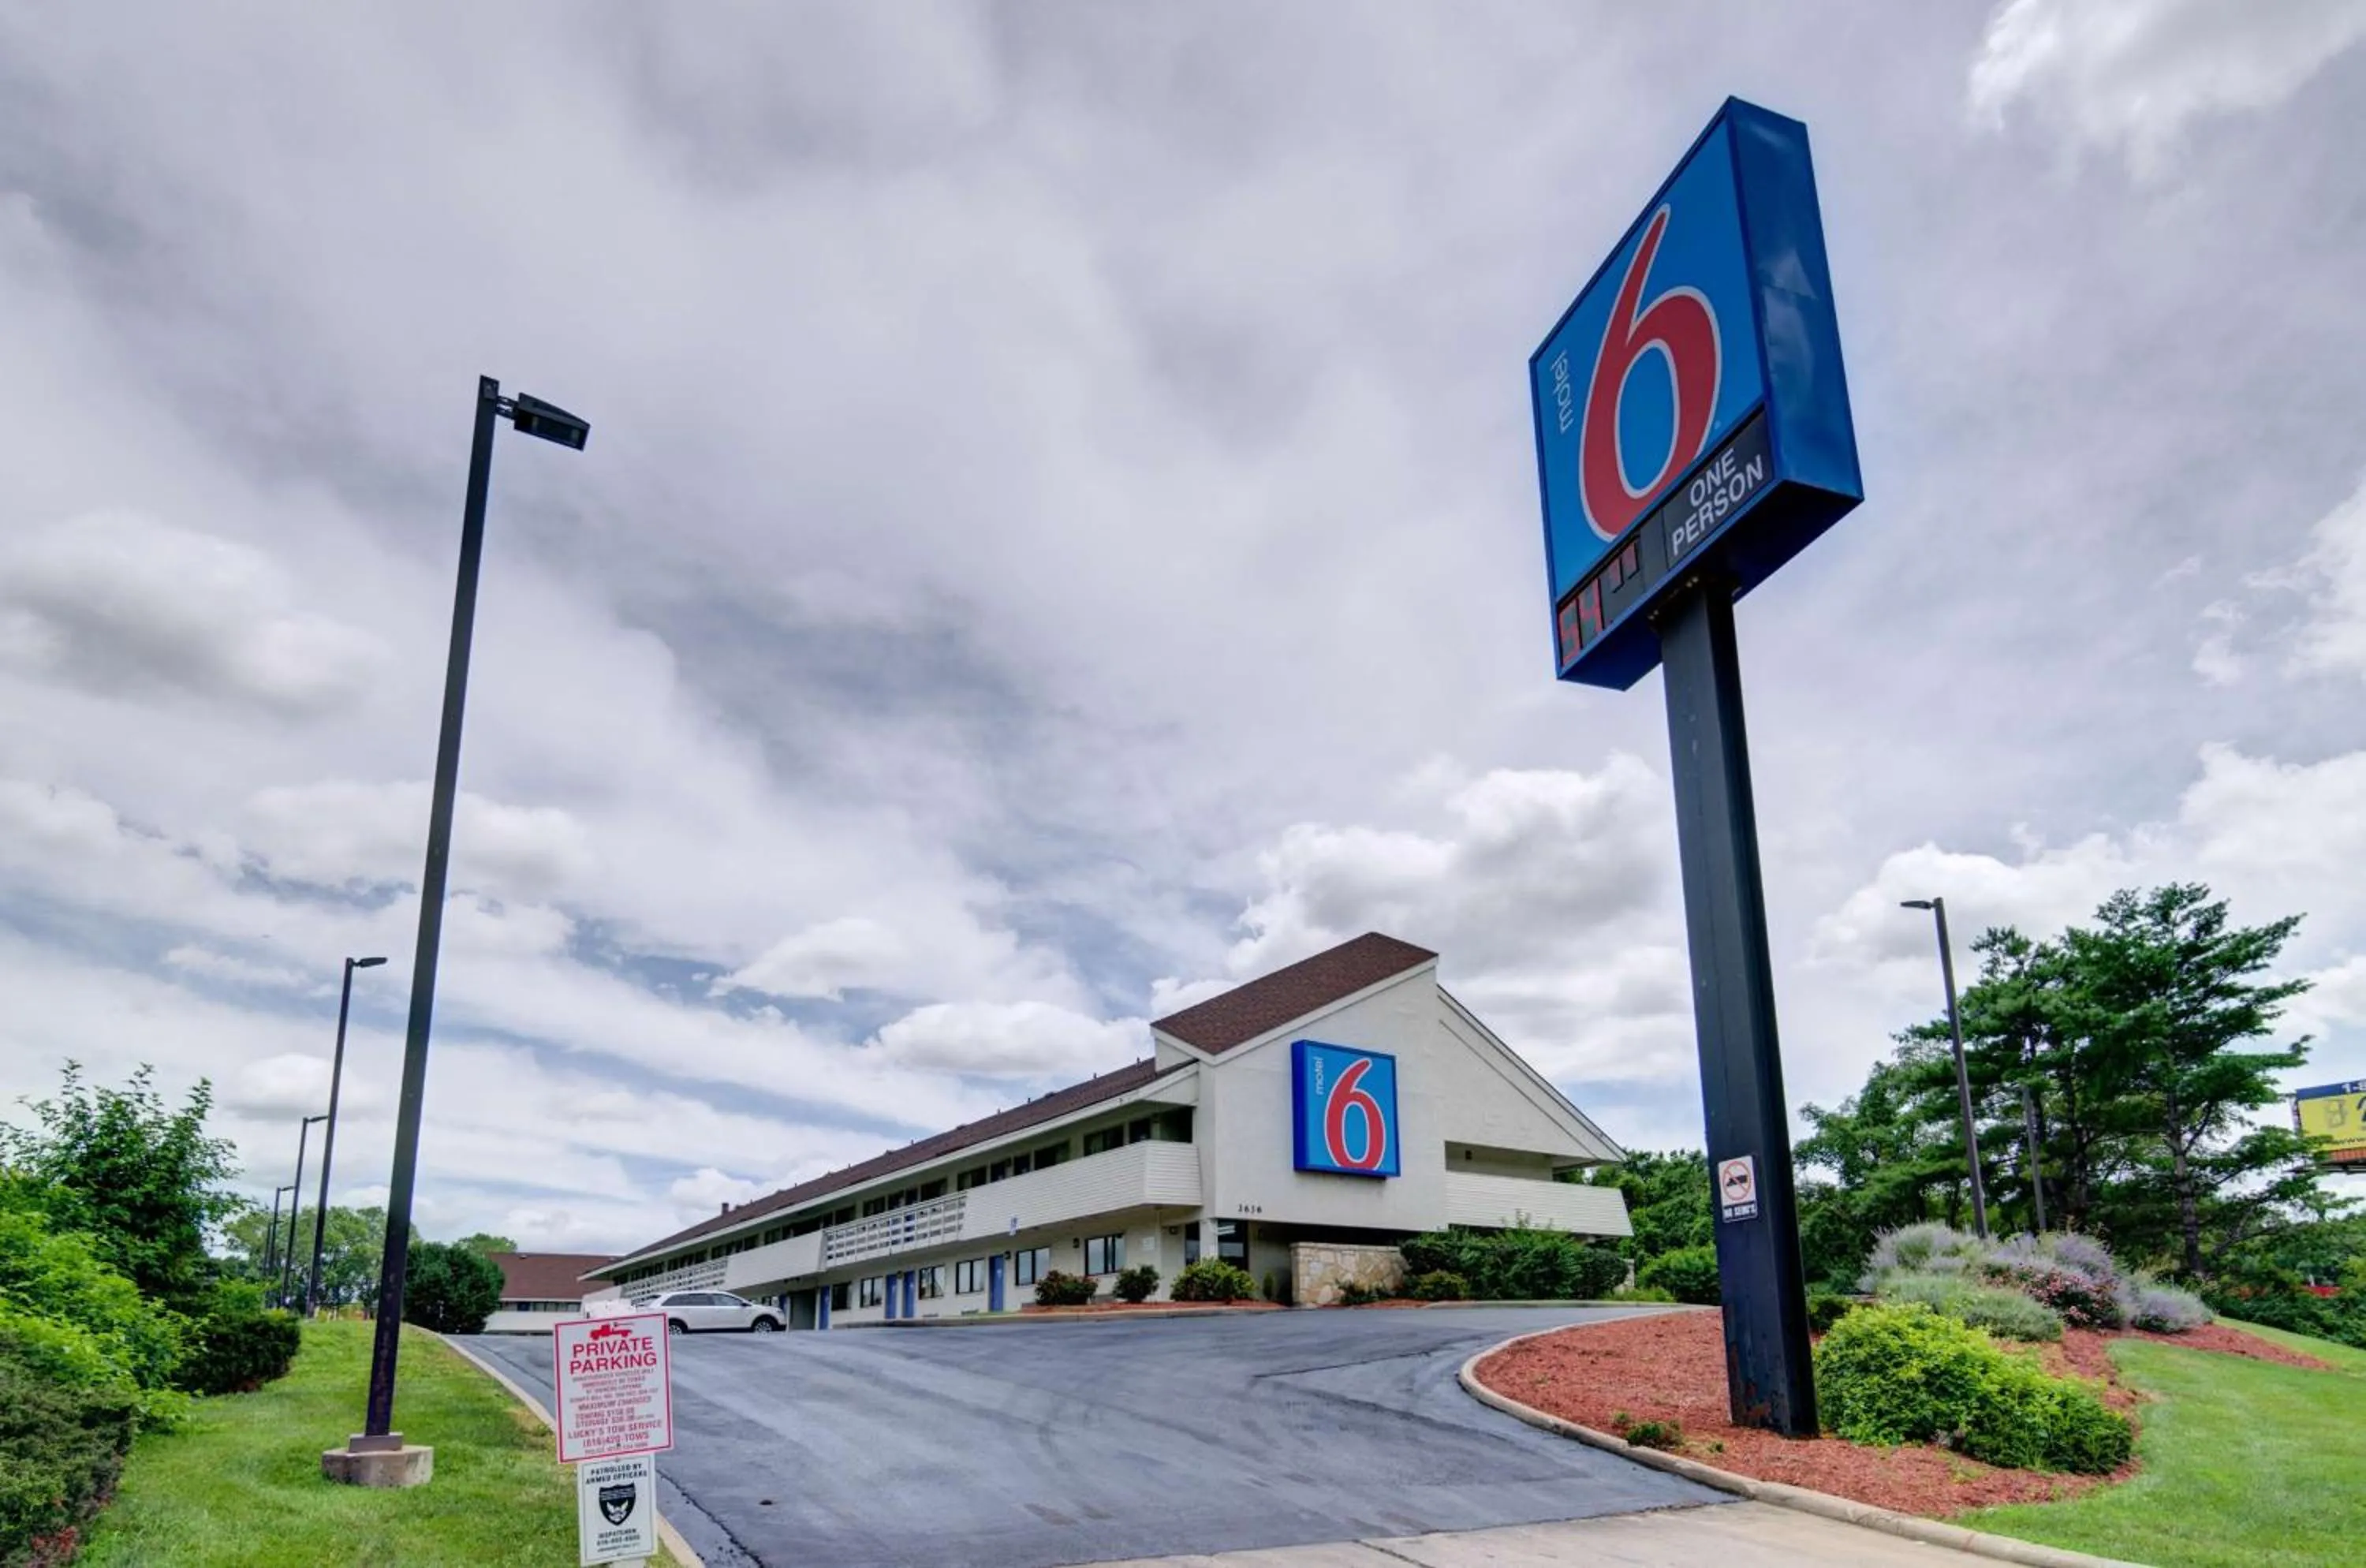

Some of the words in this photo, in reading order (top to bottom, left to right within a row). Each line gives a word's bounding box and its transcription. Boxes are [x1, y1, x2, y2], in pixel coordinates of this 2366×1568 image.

[1551, 349, 1574, 435] motel
[1578, 203, 1722, 543] 6
[1672, 454, 1763, 556] PERSON
[1690, 447, 1736, 507] ONE
[1312, 1056, 1324, 1096] motel
[1324, 1057, 1386, 1170] 6
[569, 1352, 657, 1375] PARKING
[573, 1336, 654, 1357] PRIVATE
